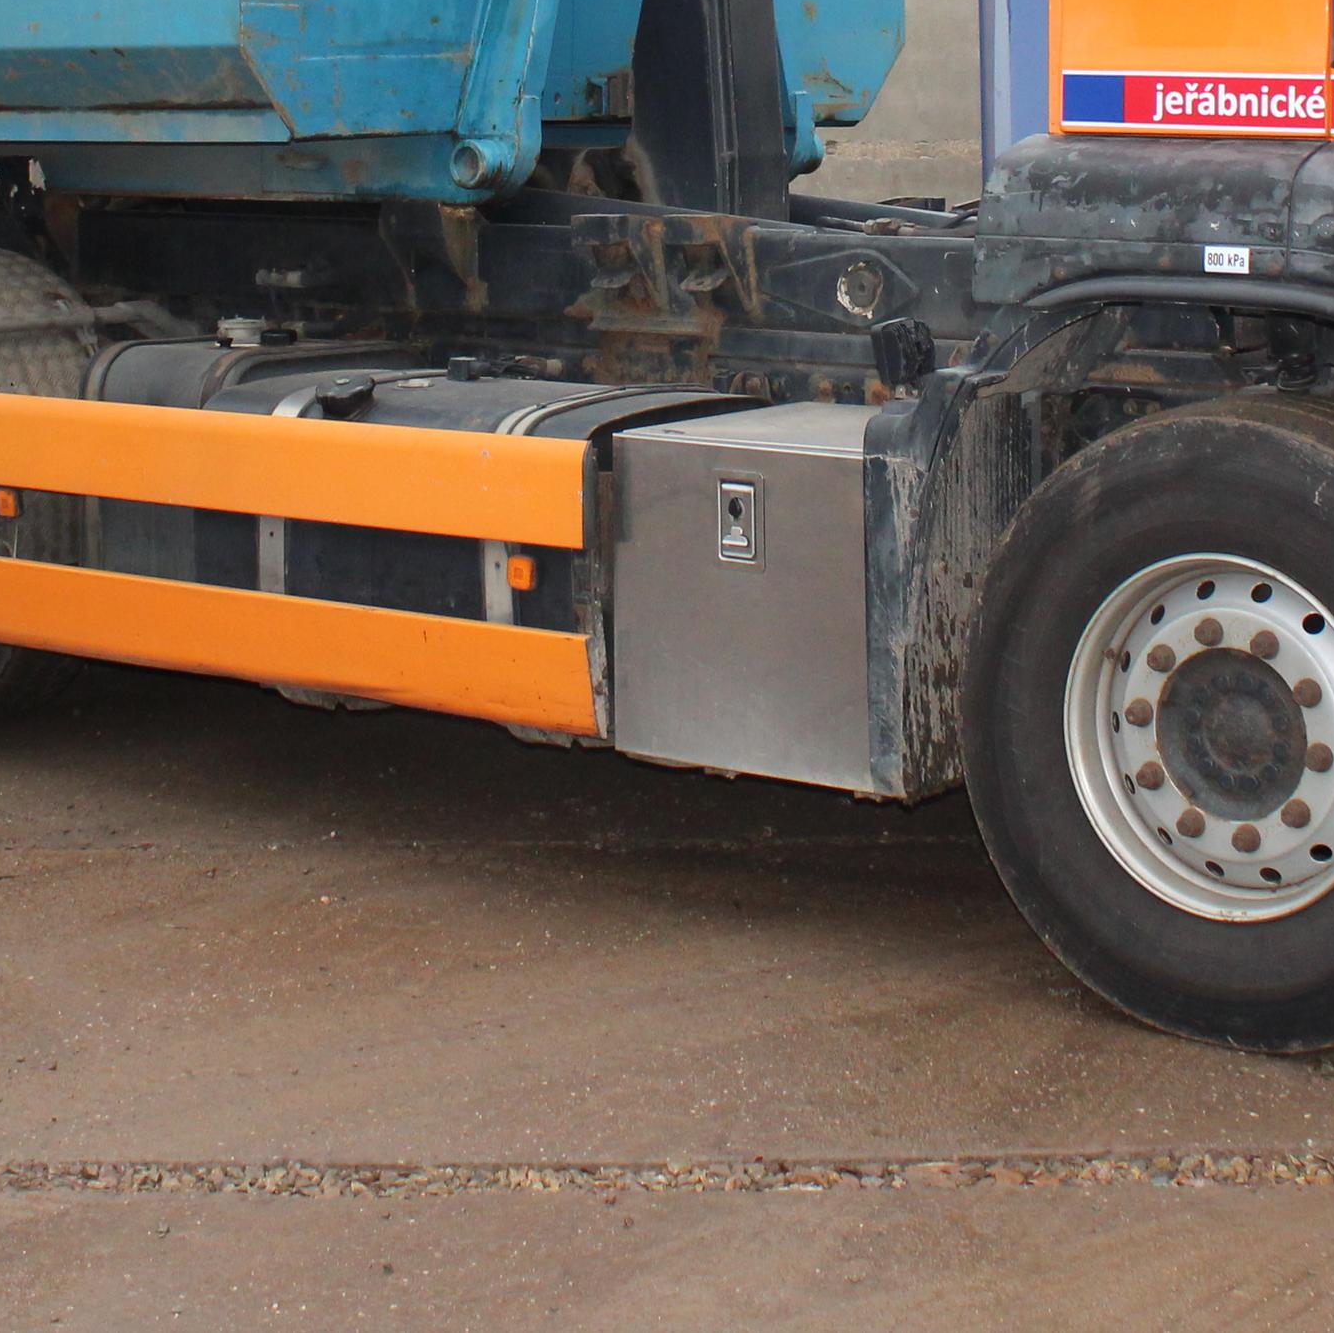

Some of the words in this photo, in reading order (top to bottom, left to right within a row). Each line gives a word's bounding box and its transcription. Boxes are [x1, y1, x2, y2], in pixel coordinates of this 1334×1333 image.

[1153, 83, 1326, 121] jeřábnické
[1207, 252, 1224, 267] 800
[1227, 253, 1245, 267] kPa
